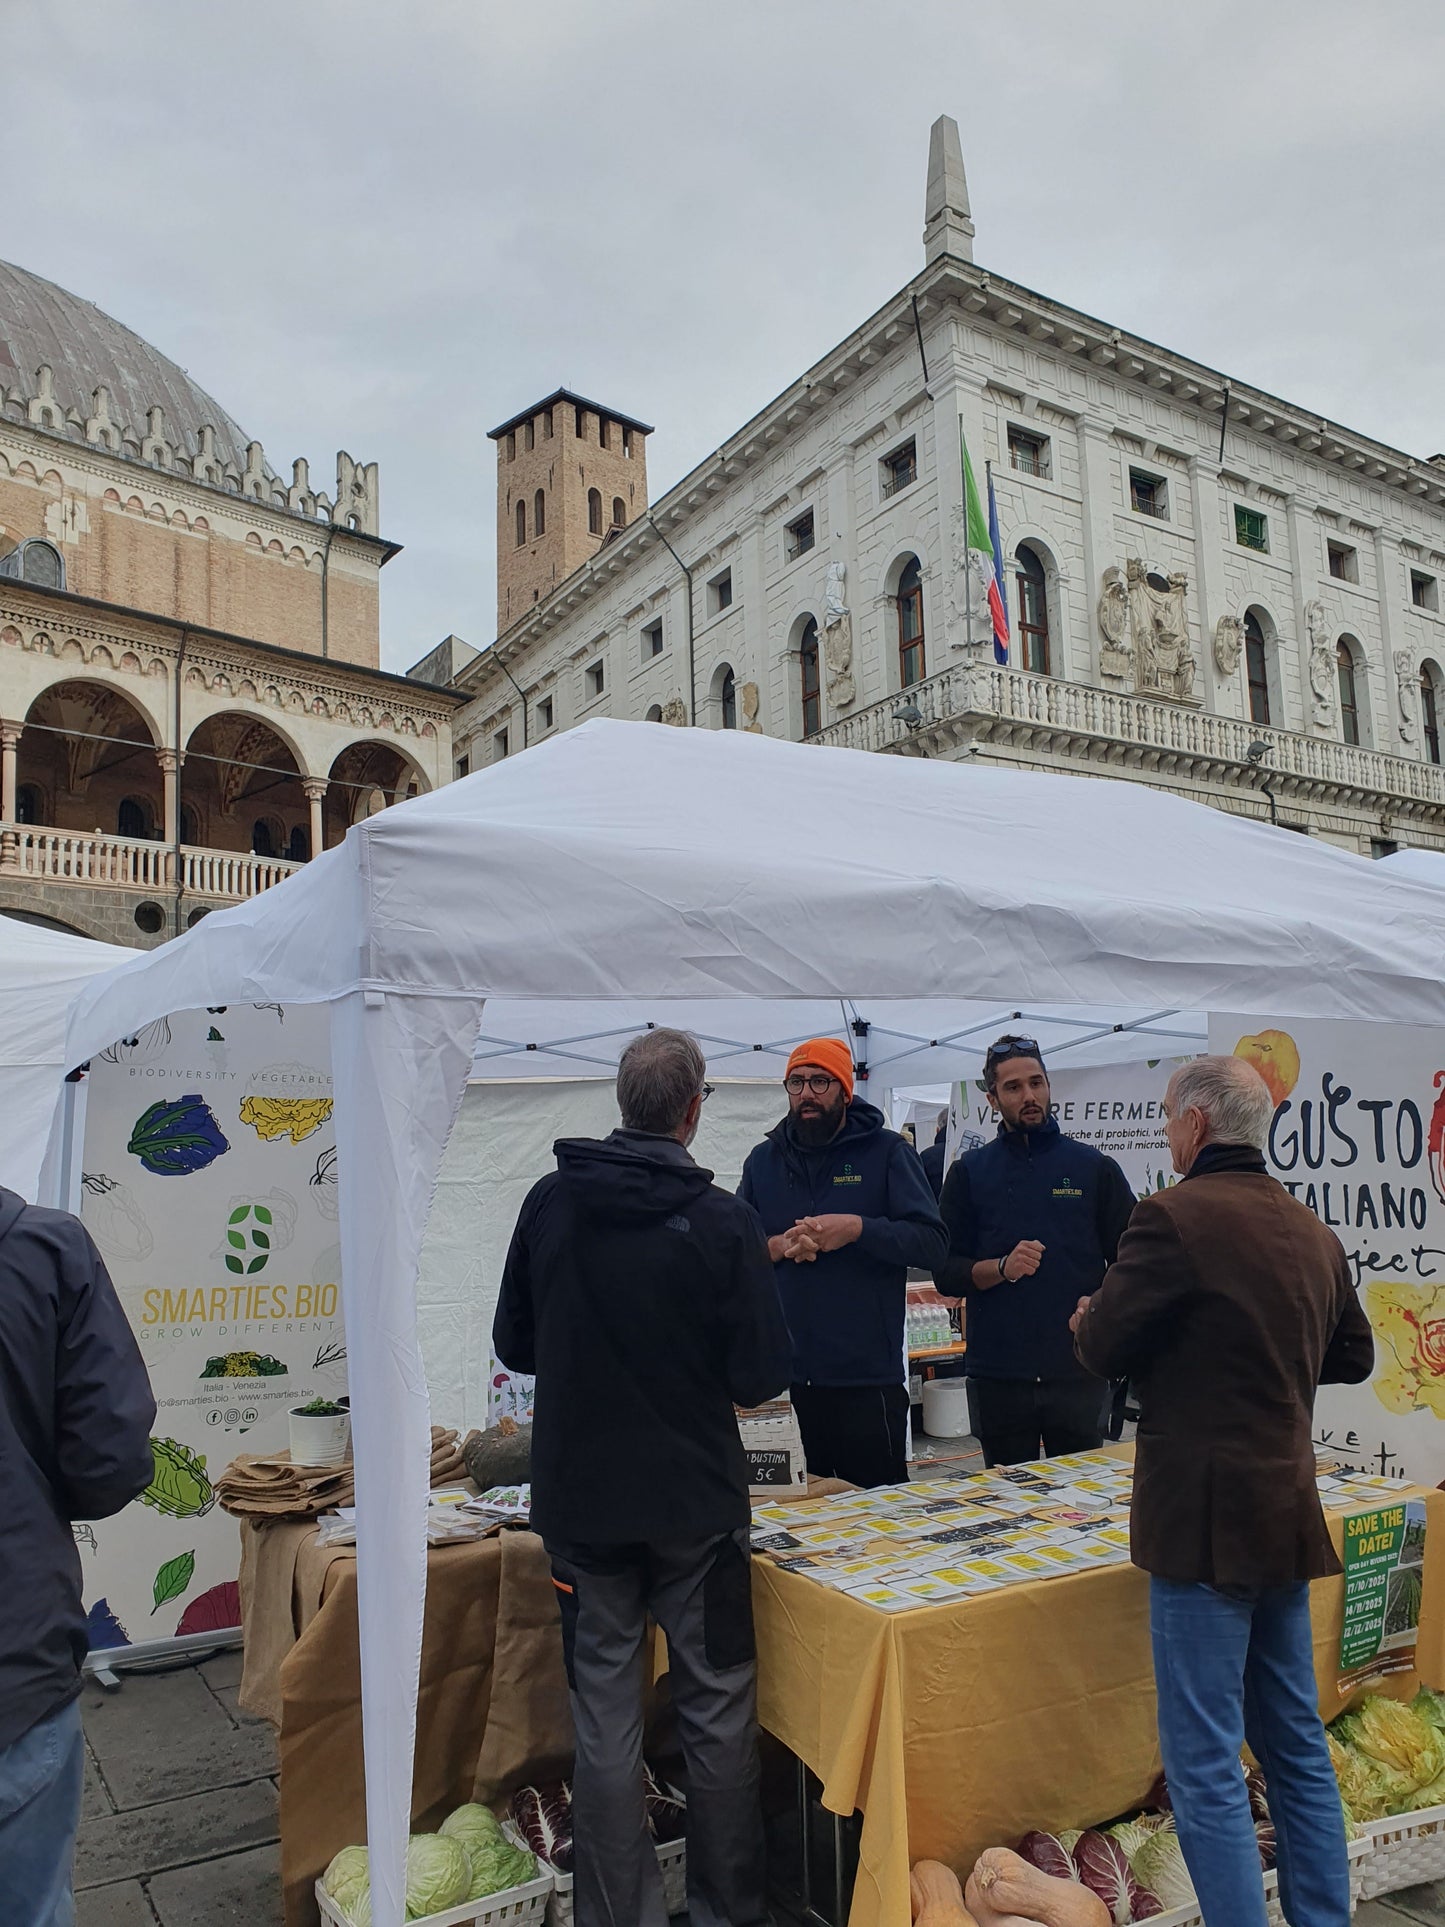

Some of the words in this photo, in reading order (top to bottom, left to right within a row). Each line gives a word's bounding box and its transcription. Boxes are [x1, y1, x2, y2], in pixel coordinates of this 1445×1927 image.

[129, 1068, 238, 1081] BIODIVERSITY
[1268, 1072, 1423, 1171] GUSTO
[1094, 1128, 1104, 1139] di
[1127, 1141, 1133, 1150] il
[1282, 1181, 1427, 1230] TALIANO
[142, 1283, 338, 1325] SMARTIES.BIO
[140, 1327, 203, 1340] GROW
[218, 1321, 337, 1337] DIFFERENT
[203, 1383, 224, 1393] Italia
[232, 1381, 267, 1391] Venezia
[157, 1395, 229, 1408] fo@smarties.bio
[237, 1388, 315, 1402] www.smarties.bio
[751, 1453, 787, 1464] BUSTINA
[755, 1468, 776, 1482] 5€
[1347, 1514, 1379, 1537] SAVE
[1381, 1508, 1404, 1529] THE
[1359, 1531, 1395, 1556] DATE!
